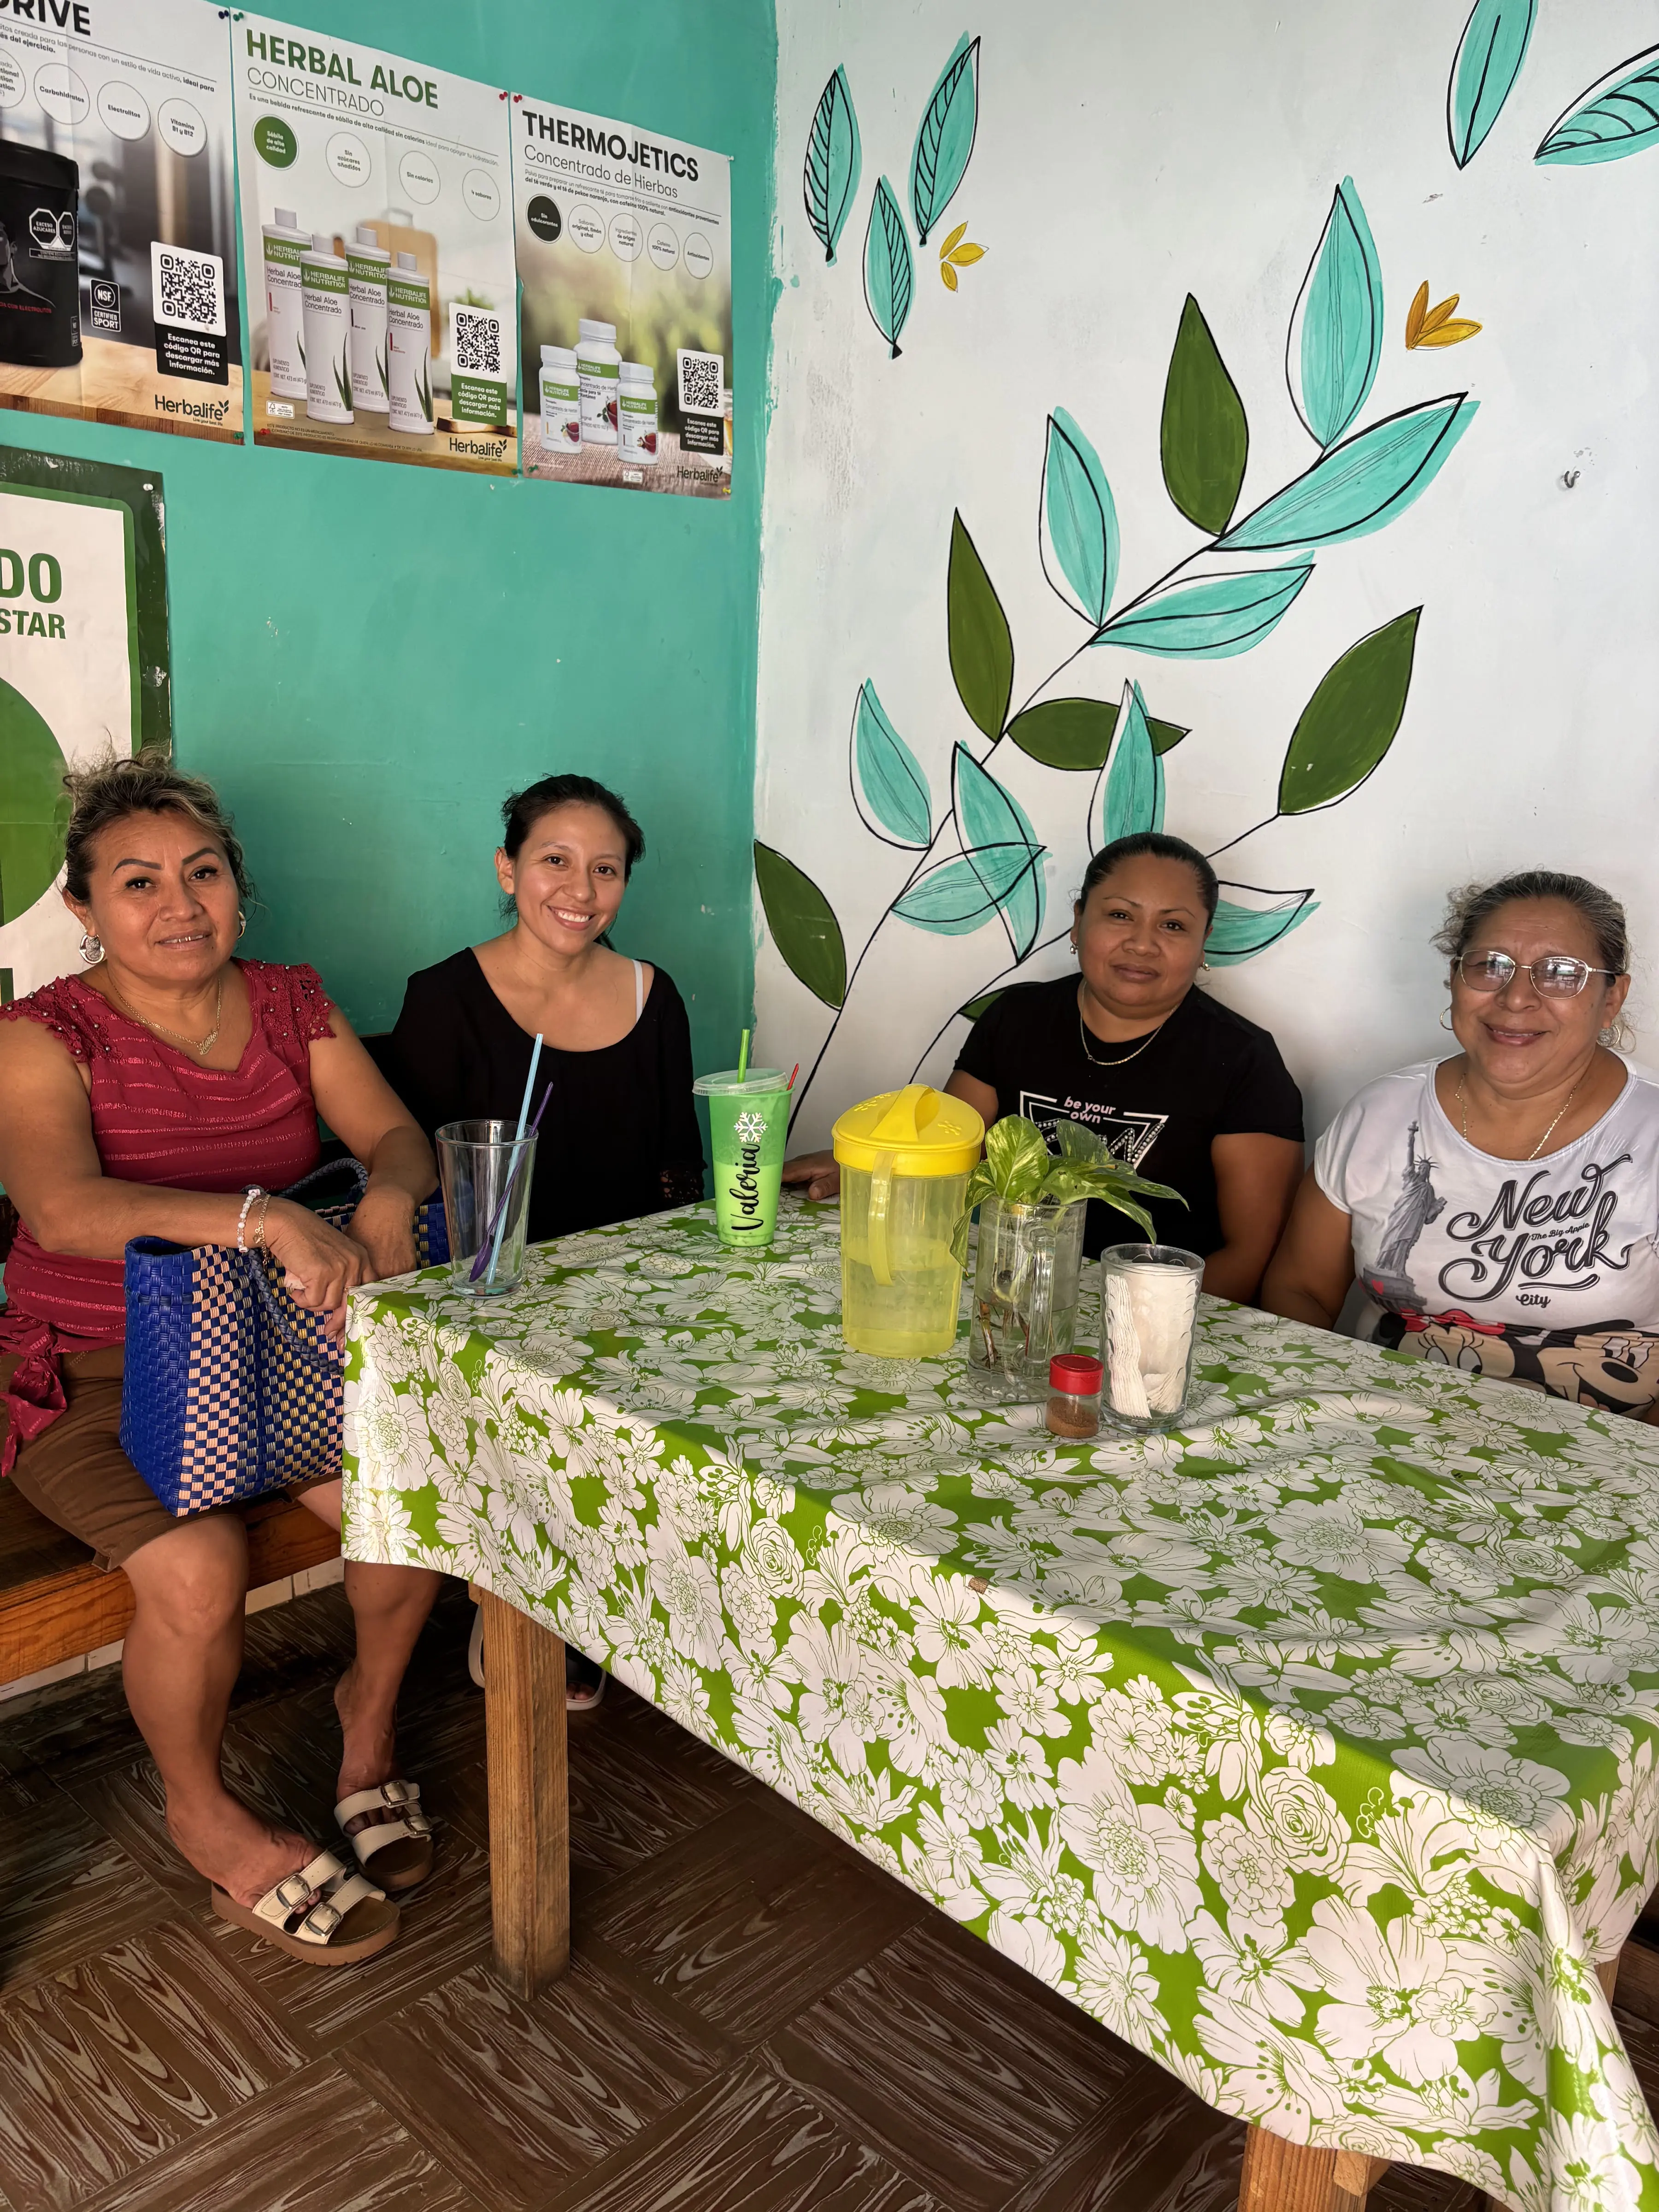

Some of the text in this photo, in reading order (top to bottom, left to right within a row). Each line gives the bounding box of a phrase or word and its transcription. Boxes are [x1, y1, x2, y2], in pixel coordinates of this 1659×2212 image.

[0, 0, 90, 36] RIVE
[10, 35, 55, 53] del ejercicio.
[14, 29, 38, 40] creada
[40, 36, 56, 45] para
[58, 39, 67, 47] las
[69, 44, 96, 57] personas
[121, 60, 137, 69] estilo
[162, 71, 182, 83] activo,
[183, 76, 199, 88] ideal
[200, 84, 214, 92] para
[247, 28, 439, 109] HERBAL ALOE
[40, 85, 85, 103] Carbohidratos
[247, 67, 384, 116] CONCENTRADO
[108, 104, 141, 118] Electrolitos
[270, 98, 291, 109] bebida
[292, 105, 326, 118] refrescante
[335, 116, 353, 125] sábila
[375, 125, 394, 135] calidad
[171, 118, 195, 130] Vitamina
[266, 145, 286, 154] calidad
[522, 110, 699, 181] THERMOJETICS
[337, 162, 360, 171] añadidos
[524, 145, 678, 198] Concentrado de Hierbas
[475, 192, 492, 200] sabores
[549, 176, 568, 185] preparar
[575, 182, 600, 193] refrescante
[669, 206, 695, 218] antioxidantes
[695, 213, 719, 225] provenientes
[589, 194, 609, 203] naranja,
[531, 217, 558, 227] edulcorantes
[267, 267, 301, 280] Herbal Aloe
[311, 271, 345, 282] HERBALIFE
[311, 277, 346, 288] NUTRITION
[349, 284, 366, 294] Herbal
[98, 289, 112, 301] NSF
[304, 293, 338, 305] Herbal Aloe
[349, 292, 385, 305] Concentrado
[395, 288, 427, 298] HERBALIFE
[395, 293, 427, 304] NUTRITION
[305, 300, 342, 314] Concentrado
[94, 310, 118, 321] CERTIFIED
[388, 308, 419, 320] Herbal Aloe
[94, 317, 118, 329] SPORT
[388, 316, 424, 329] Concentrado
[168, 333, 215, 349] Escanea este
[164, 342, 220, 359] código QR para
[165, 351, 203, 364] descargar
[169, 360, 215, 375] información.
[461, 383, 484, 392] Escanea
[155, 394, 224, 421] Herbalife
[459, 399, 487, 409] descargar
[462, 407, 497, 418] información.
[687, 418, 706, 426] Escanea
[685, 432, 708, 441] descargar
[450, 437, 502, 457] Herbalife
[687, 439, 716, 448] información.
[677, 465, 719, 482] Herbalife
[0, 548, 62, 603] DO
[1064, 1096, 1116, 1116] be your
[1070, 1111, 1101, 1124] own
[729, 1143, 764, 1230] Valeria
[1446, 1154, 1633, 1241] New
[1565, 1222, 1590, 1234] Apple
[1438, 1190, 1635, 1302] York
[1516, 1293, 1551, 1308] City
